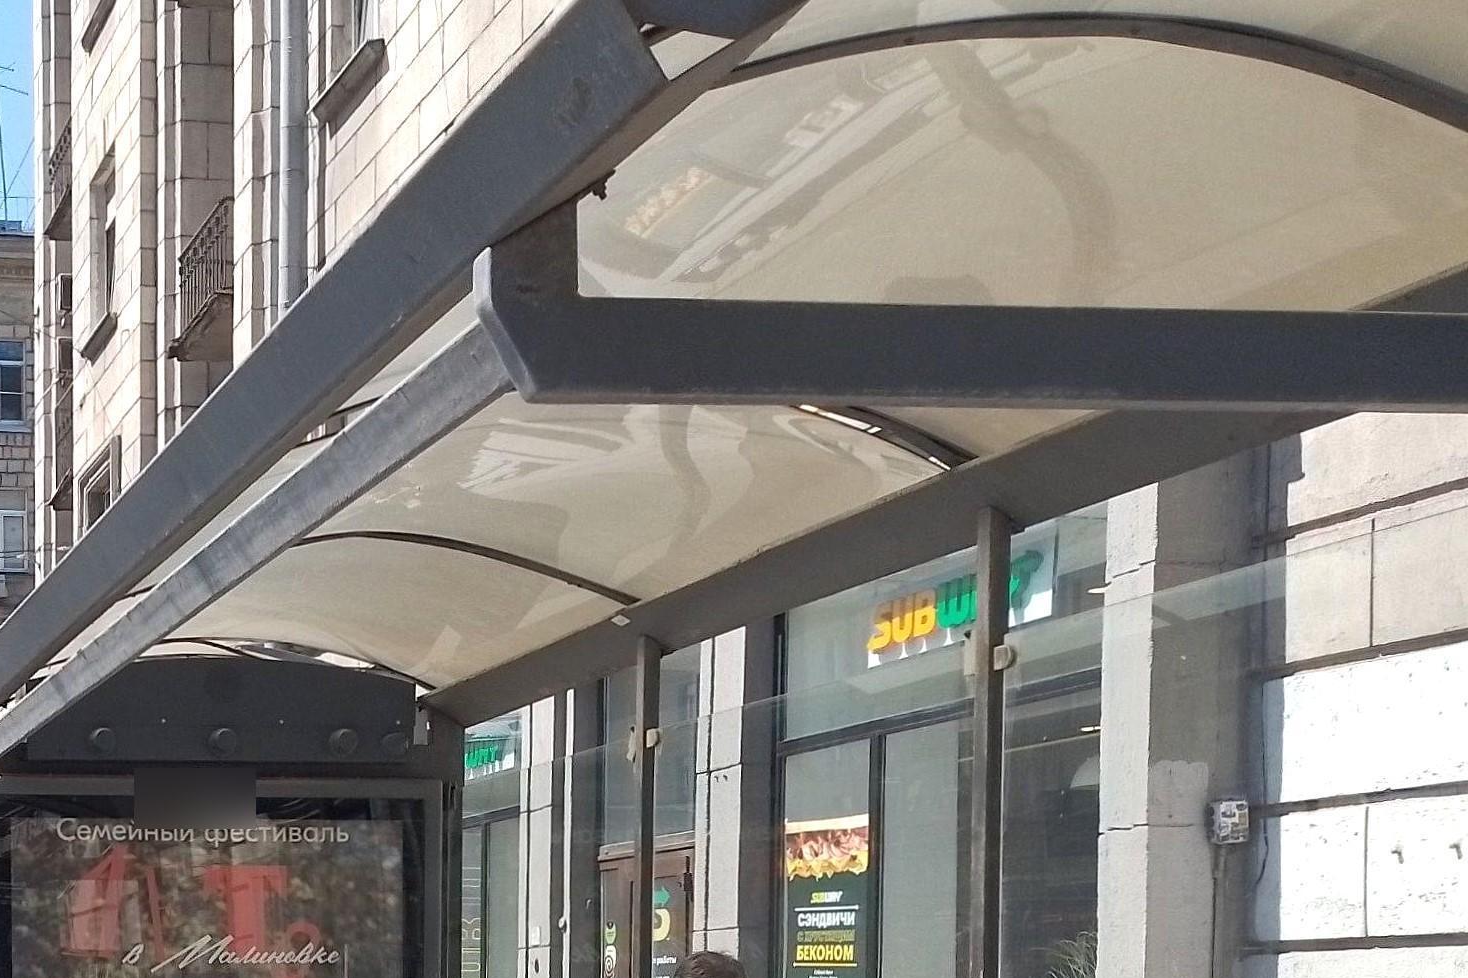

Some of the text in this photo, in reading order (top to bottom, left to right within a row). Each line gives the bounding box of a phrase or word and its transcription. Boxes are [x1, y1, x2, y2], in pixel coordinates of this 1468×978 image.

[867, 550, 1044, 653] SUBWY
[797, 911, 856, 929] СЭНДВИЧИ
[122, 934, 340, 973] в Малиновке
[796, 944, 855, 961] БЕКОНОМ
